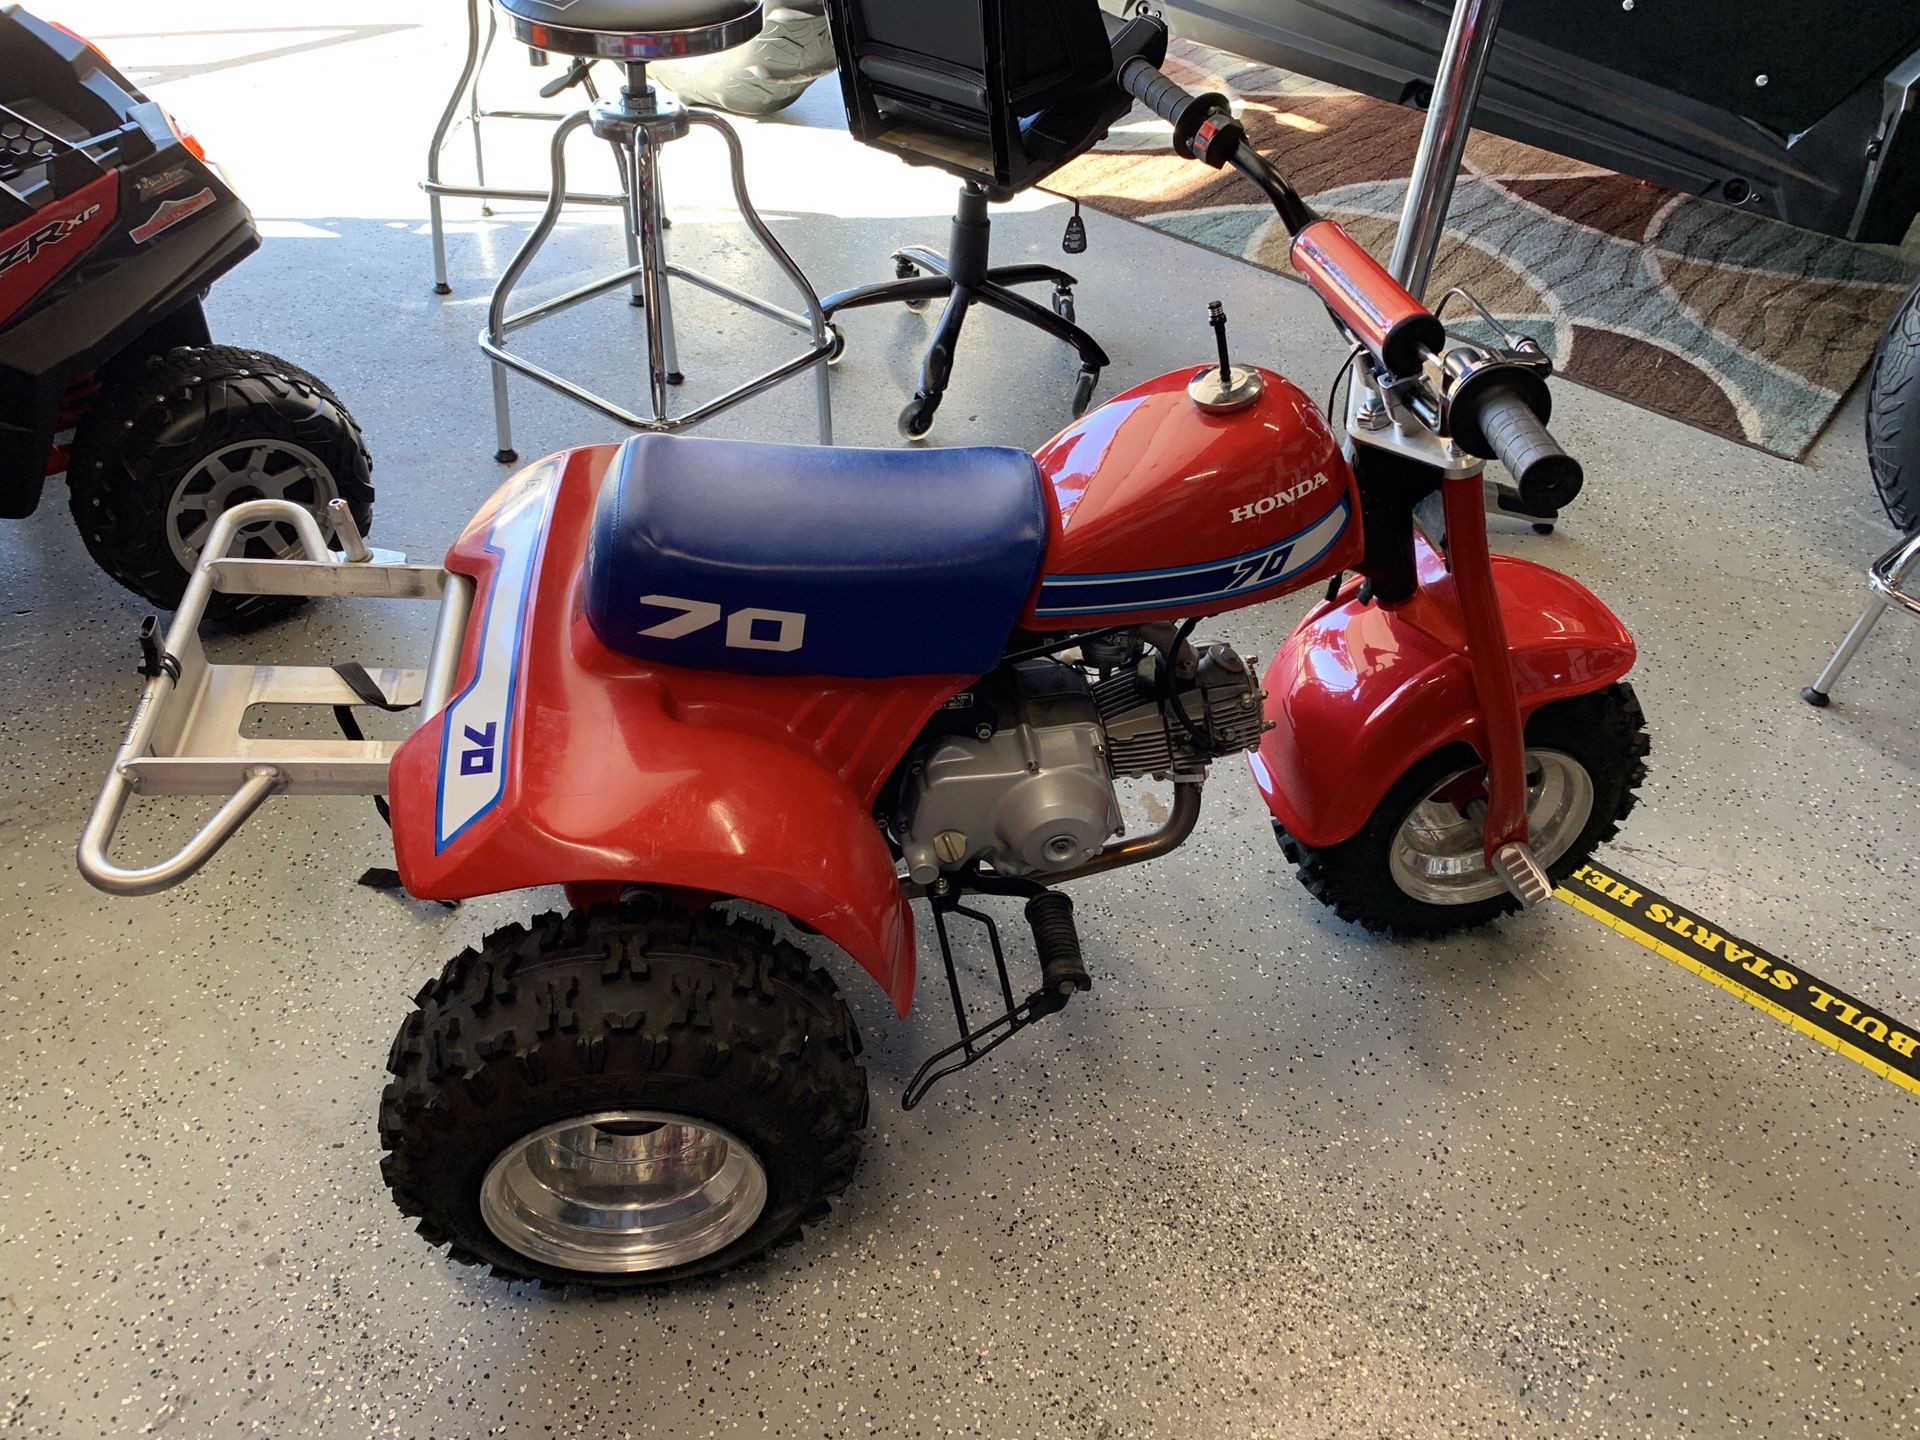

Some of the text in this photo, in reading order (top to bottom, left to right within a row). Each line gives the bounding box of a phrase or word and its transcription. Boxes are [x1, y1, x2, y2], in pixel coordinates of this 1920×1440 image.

[66, 203, 100, 231] XP
[1229, 471, 1329, 524] HONDA
[1227, 543, 1296, 591] 70
[637, 594, 806, 652] 70
[459, 721, 497, 776] 70
[1644, 903, 1799, 991] STARTS
[1807, 985, 1920, 1058] BULL
